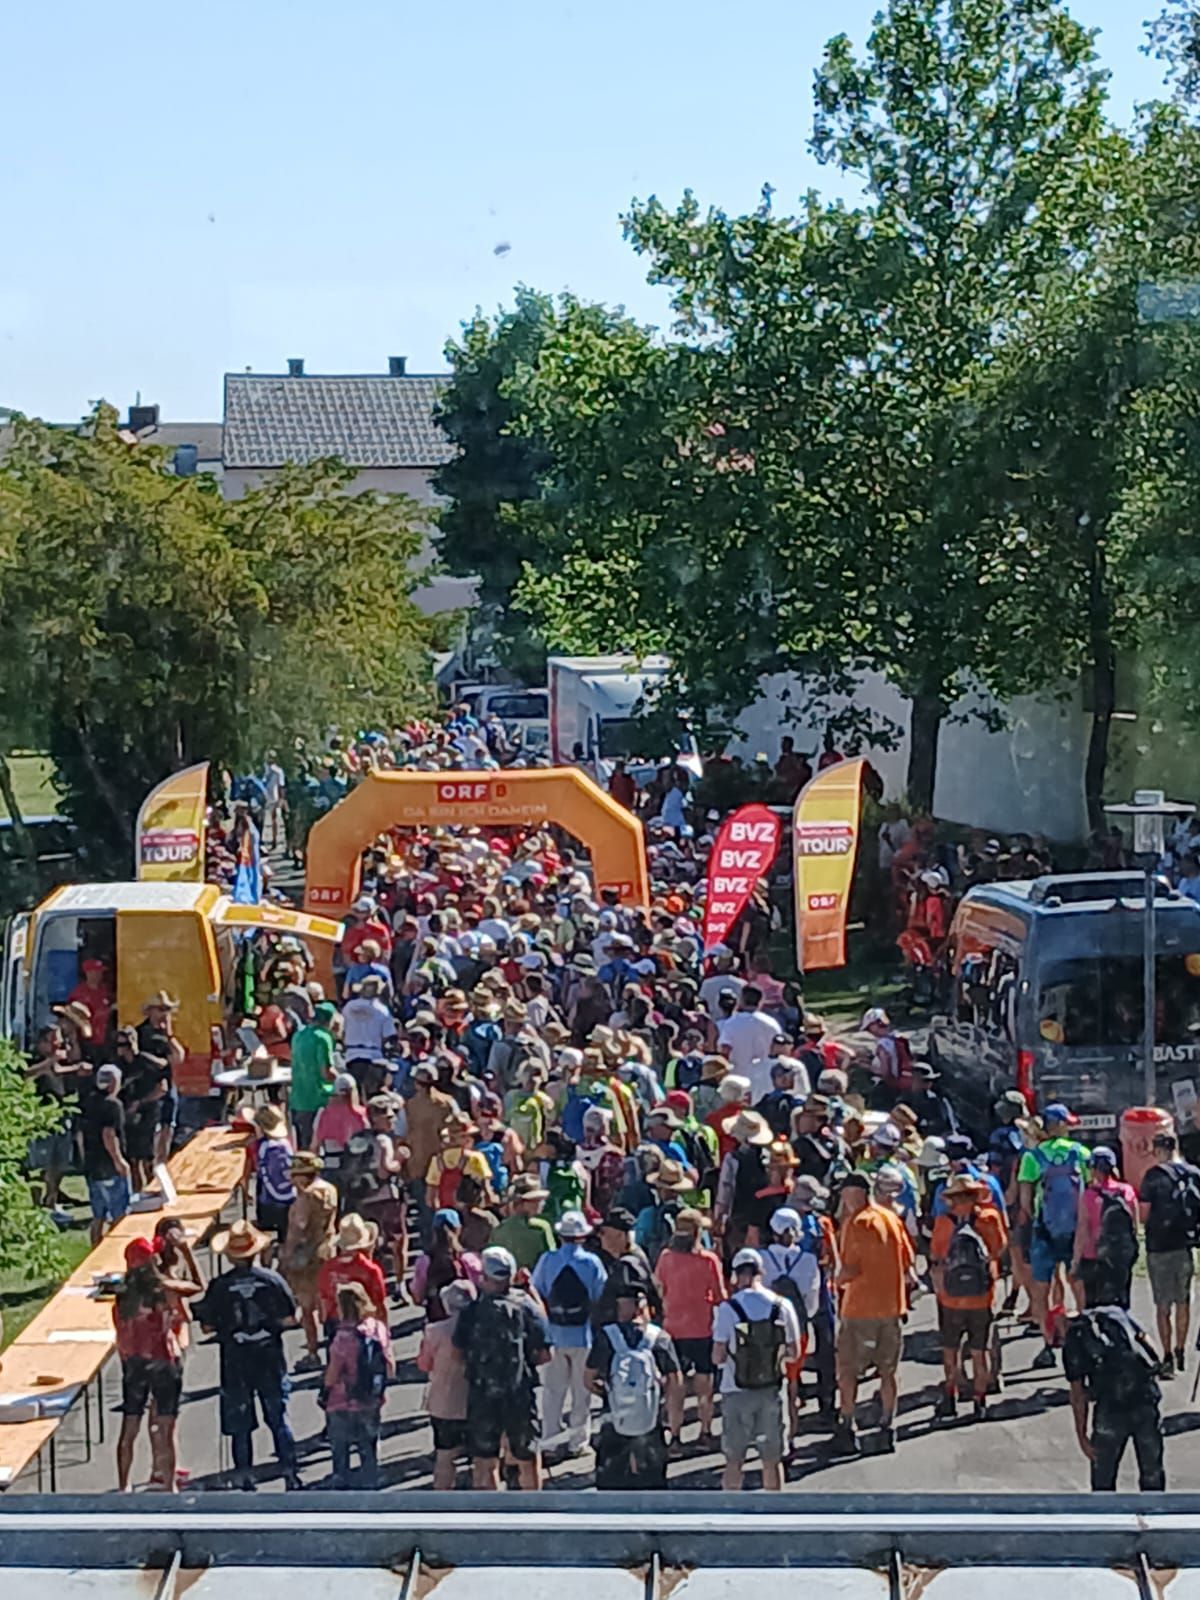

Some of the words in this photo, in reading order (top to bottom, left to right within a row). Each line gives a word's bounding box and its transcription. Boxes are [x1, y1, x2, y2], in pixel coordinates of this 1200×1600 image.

[440, 784, 487, 799] ORF
[730, 822, 775, 842] BVZ
[800, 838, 849, 853] TOUR
[143, 846, 193, 861] TOUR
[720, 849, 762, 869] BVZ
[713, 876, 748, 893] BVZ
[711, 902, 736, 914] BVZ
